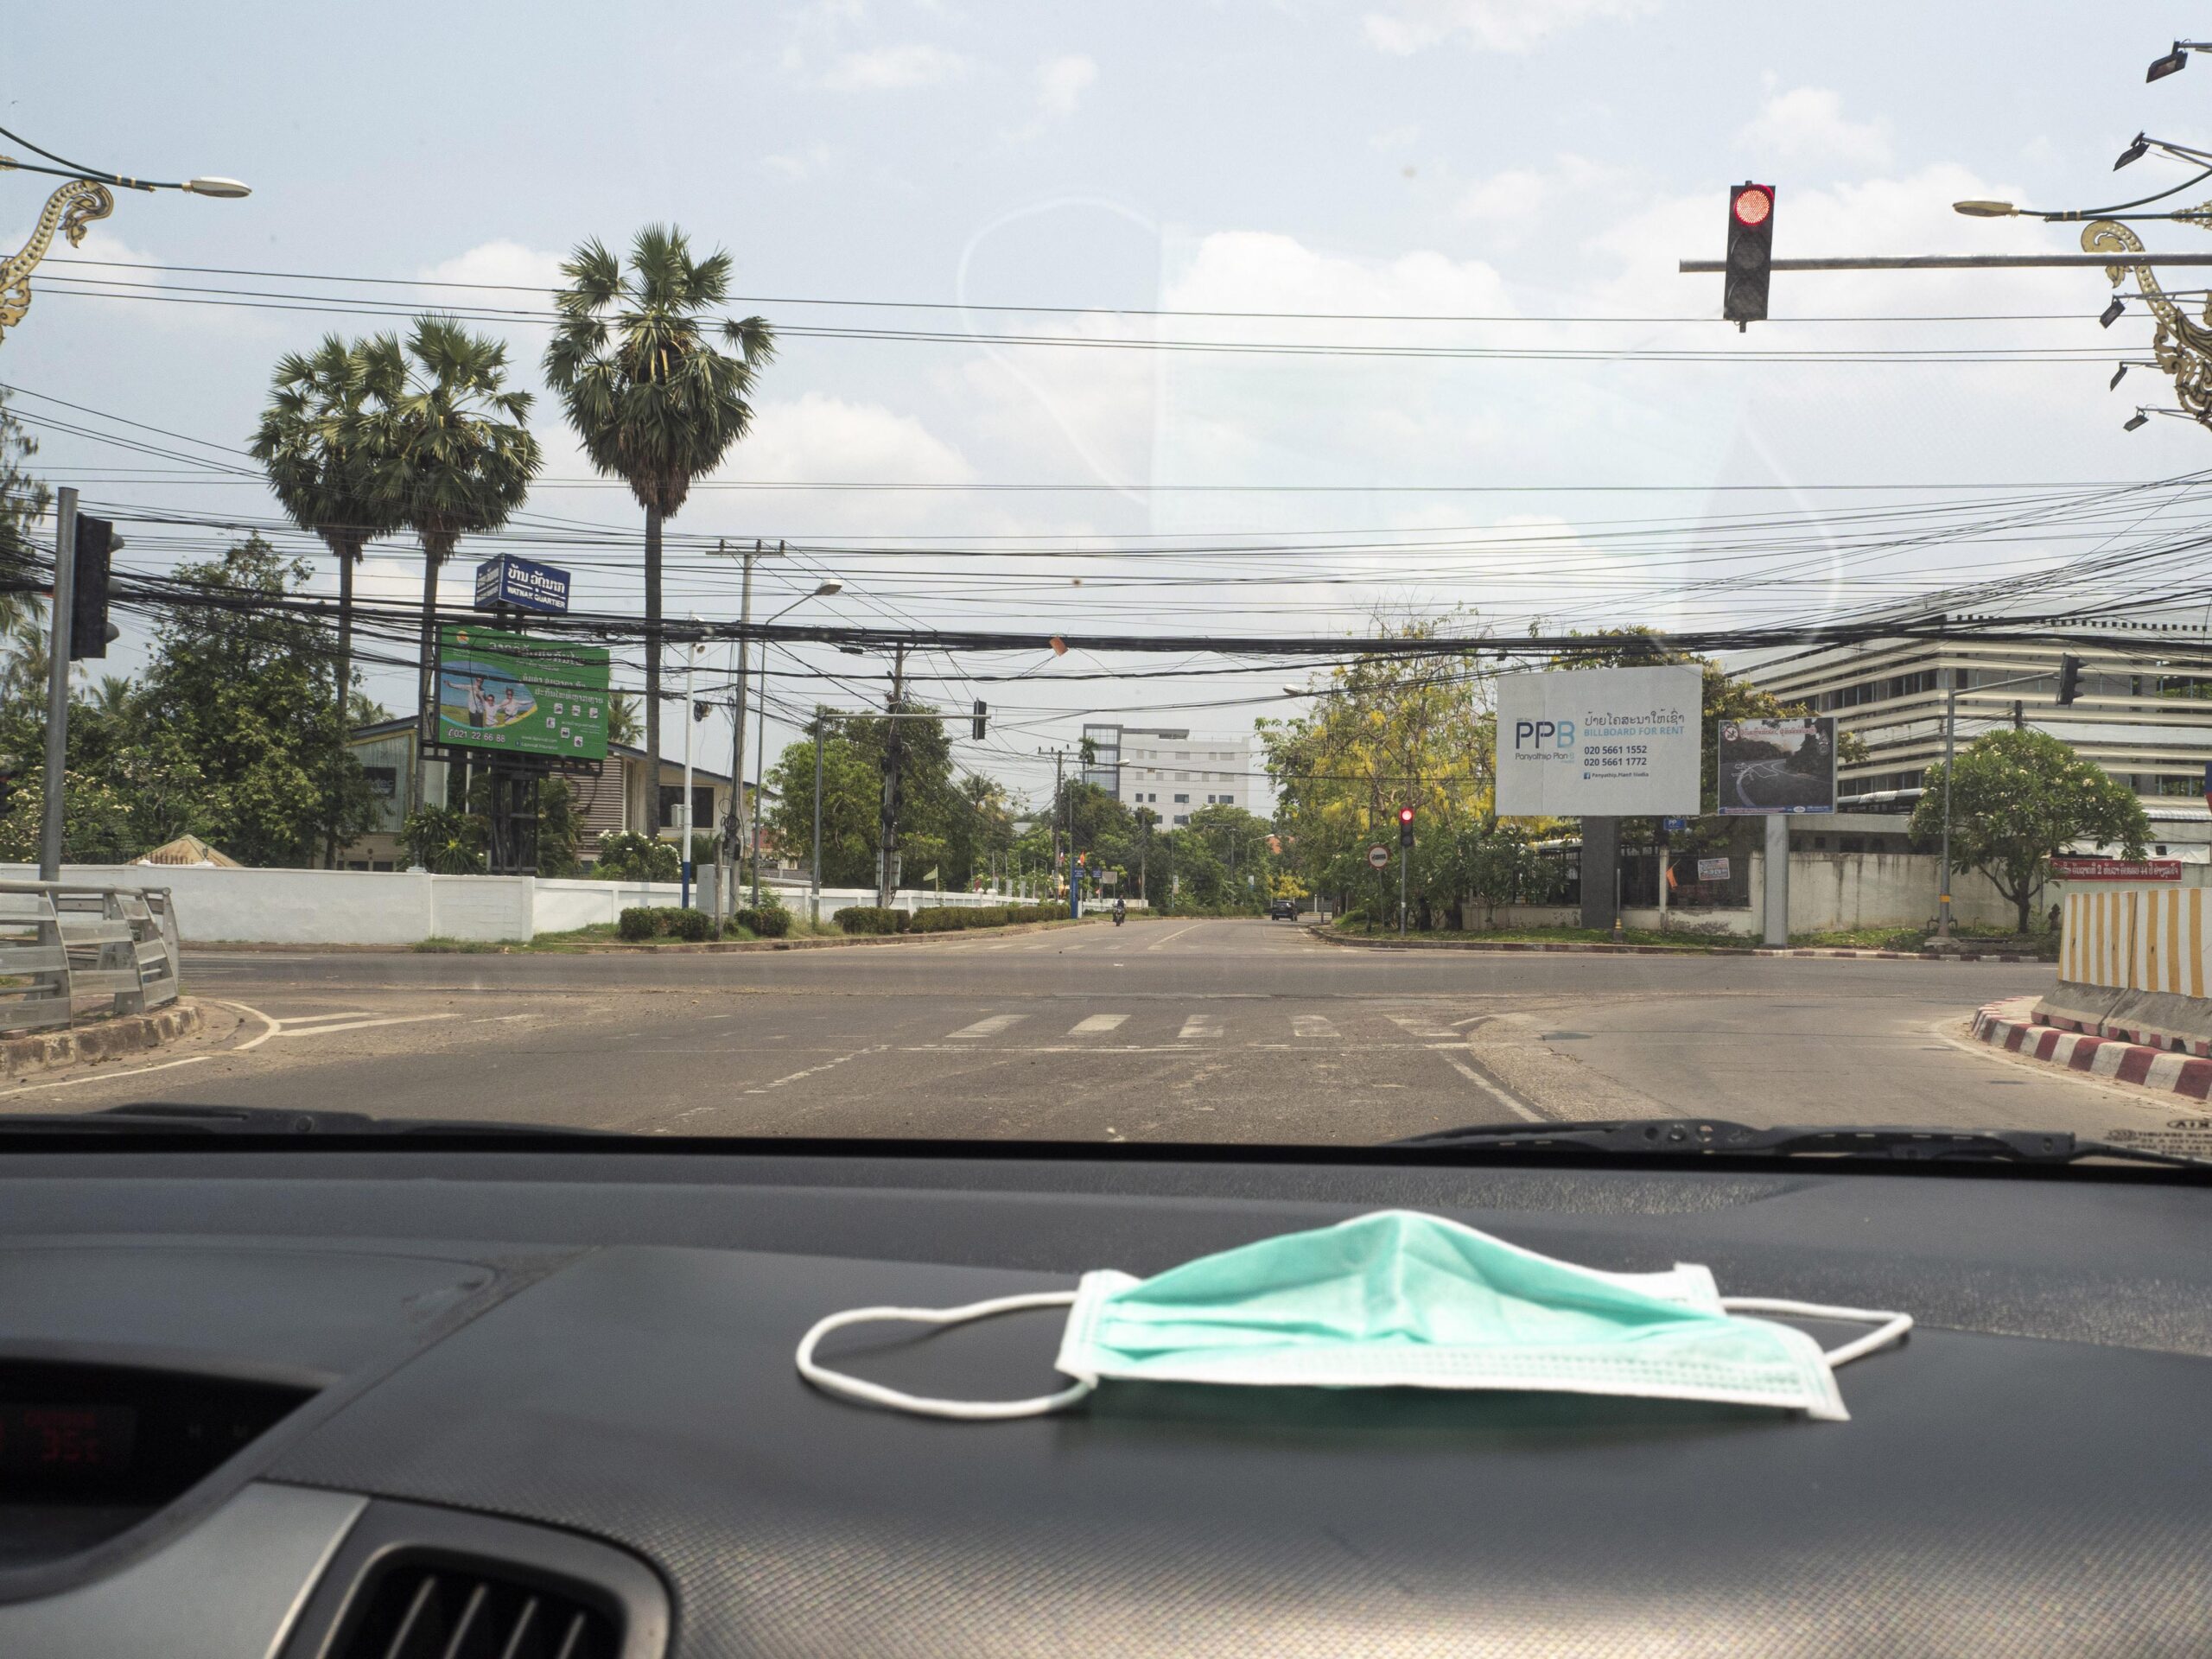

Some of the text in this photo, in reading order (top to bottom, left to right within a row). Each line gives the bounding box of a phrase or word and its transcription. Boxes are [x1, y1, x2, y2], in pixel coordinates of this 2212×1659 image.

[506, 586, 533, 601] WATNAK
[534, 594, 566, 609] QUARTIER
[454, 729, 505, 743] 021 22 66 88
[1516, 721, 1575, 749] PPB
[1584, 726, 1685, 737] BILLBOARD FOR RENT
[1584, 745, 1647, 754] 020 5661 1552
[1584, 757, 1647, 766] 020 5661 1772
[2097, 864, 2102, 874] 2
